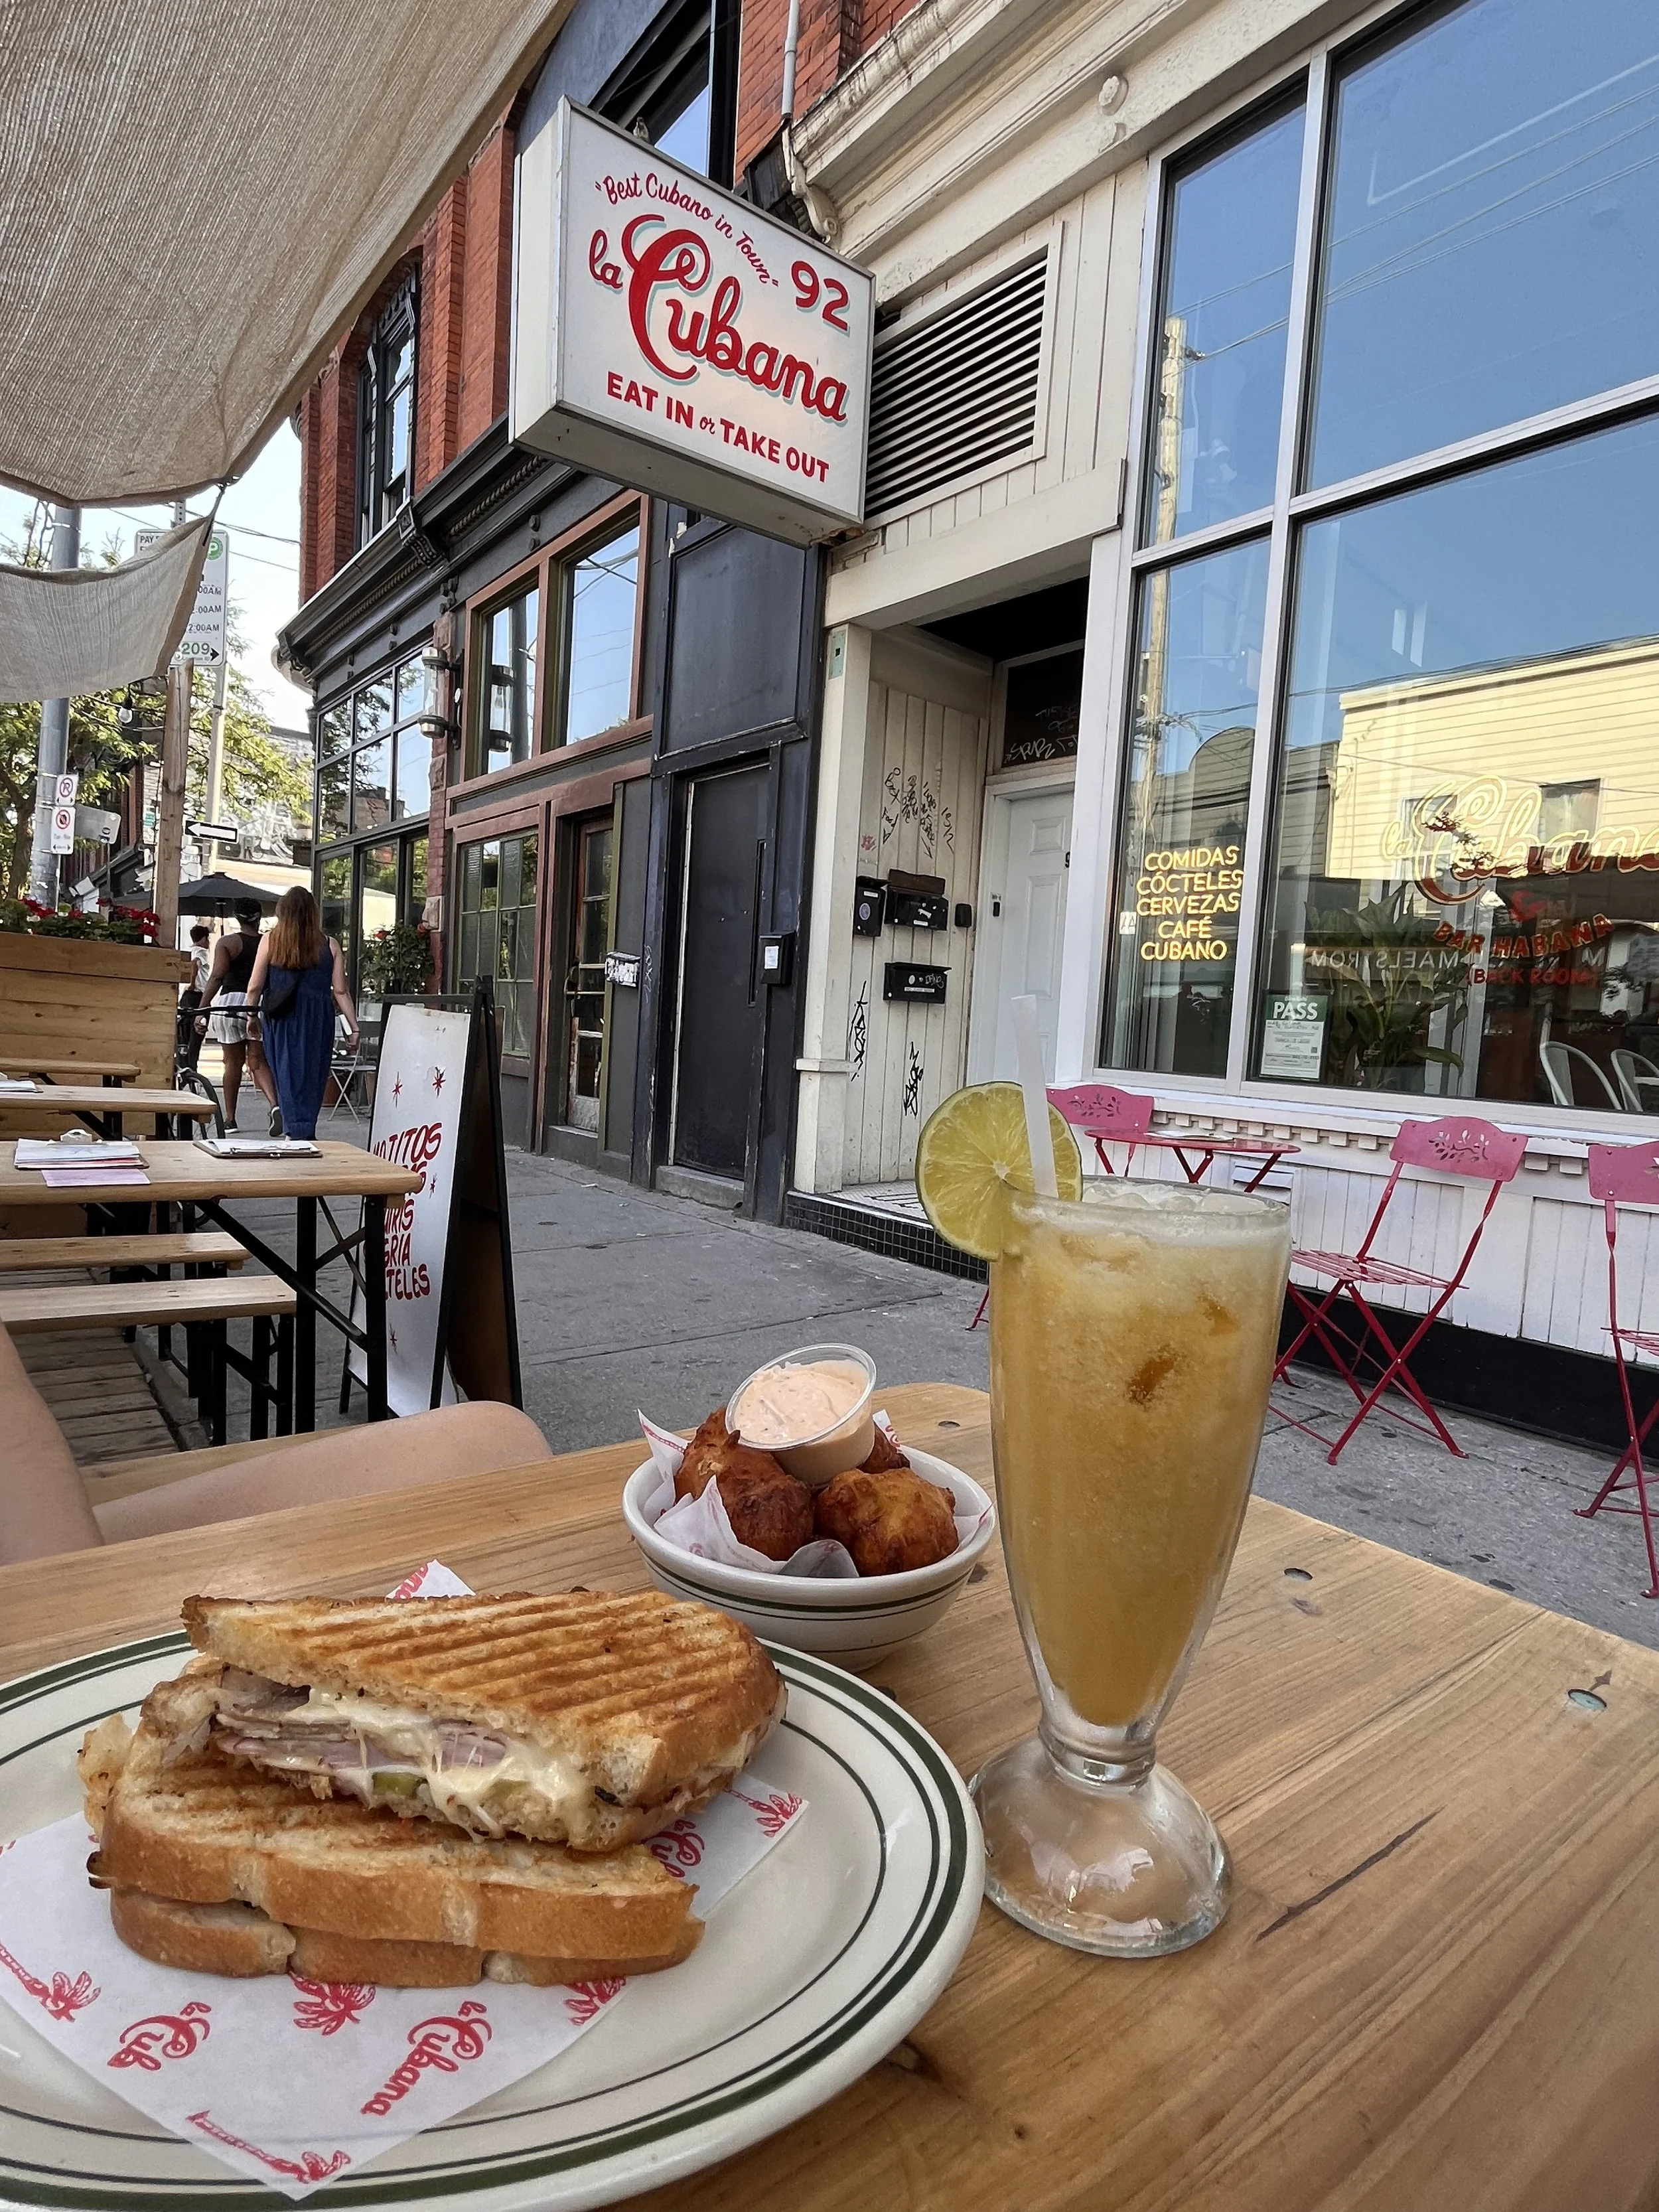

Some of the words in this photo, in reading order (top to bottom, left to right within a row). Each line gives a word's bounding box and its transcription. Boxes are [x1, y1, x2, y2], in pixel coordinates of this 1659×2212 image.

[646, 173, 713, 220] Cubano
[715, 213, 733, 239] in
[790, 259, 849, 331] 92
[589, 229, 623, 289] la
[620, 213, 847, 421] Cubana
[607, 370, 658, 412] EAT
[666, 396, 694, 429] IN
[699, 415, 716, 435] or
[719, 417, 781, 464] TAKE
[785, 446, 830, 483] OUT
[198, 585, 222, 596] 00AM
[181, 642, 210, 655] 209
[1144, 845, 1240, 871] COMIDAS
[1135, 869, 1245, 895] CÓCTELES
[1136, 891, 1242, 917] CERVEZAS
[1157, 915, 1213, 939] CAFÉ
[1433, 920, 1486, 954] BAR
[1492, 912, 1616, 960] HABANA
[1140, 939, 1228, 960] CUBANO
[1273, 1001, 1318, 1021] PASS
[359, 2015, 492, 2116] Cubana
